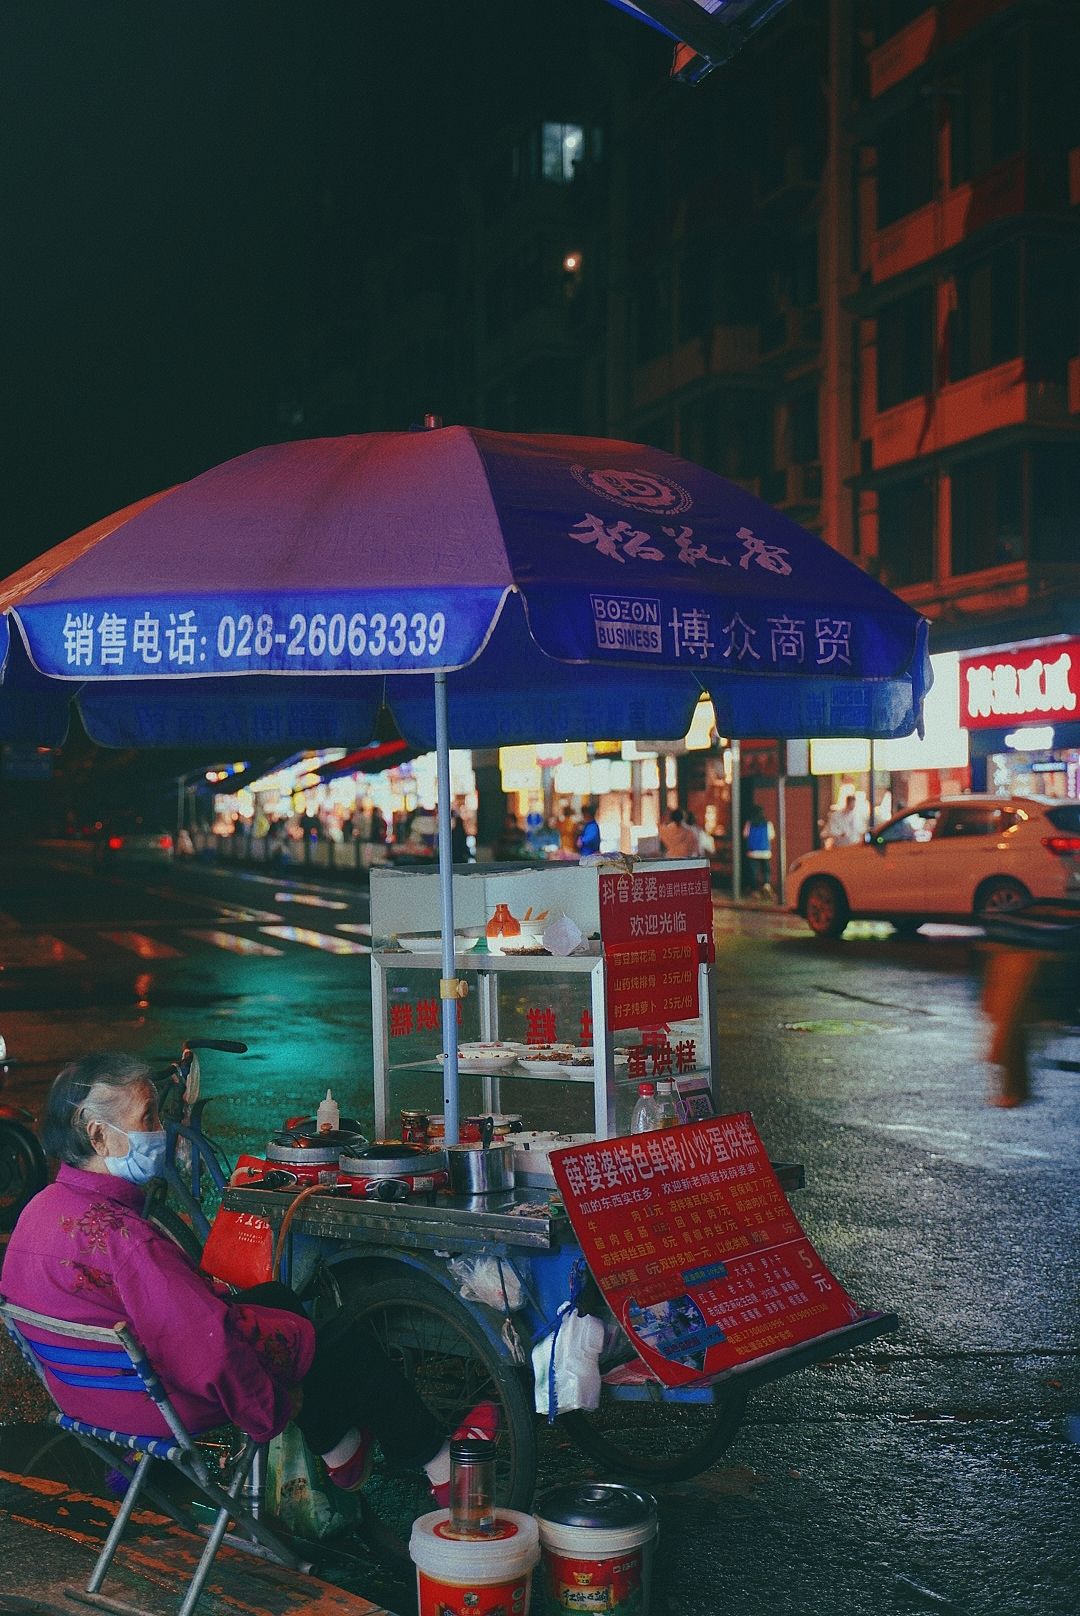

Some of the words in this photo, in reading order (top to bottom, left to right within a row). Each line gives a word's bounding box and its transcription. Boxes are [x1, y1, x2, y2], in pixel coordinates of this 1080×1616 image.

[217, 611, 446, 657] 028-26063339
[598, 625, 659, 649] BUSINESS
[668, 606, 852, 665] 博众商贸
[630, 912, 687, 936] 欢迎光临
[662, 945, 692, 960] 25元/份
[613, 974, 656, 991] 山药炖排骨
[662, 970, 693, 985] 25元/份
[663, 995, 693, 1010] 25元/份
[561, 1123, 761, 1196] 薛婆婆特色单锅小炒蛋烘糕
[661, 1234, 678, 1249] 8元
